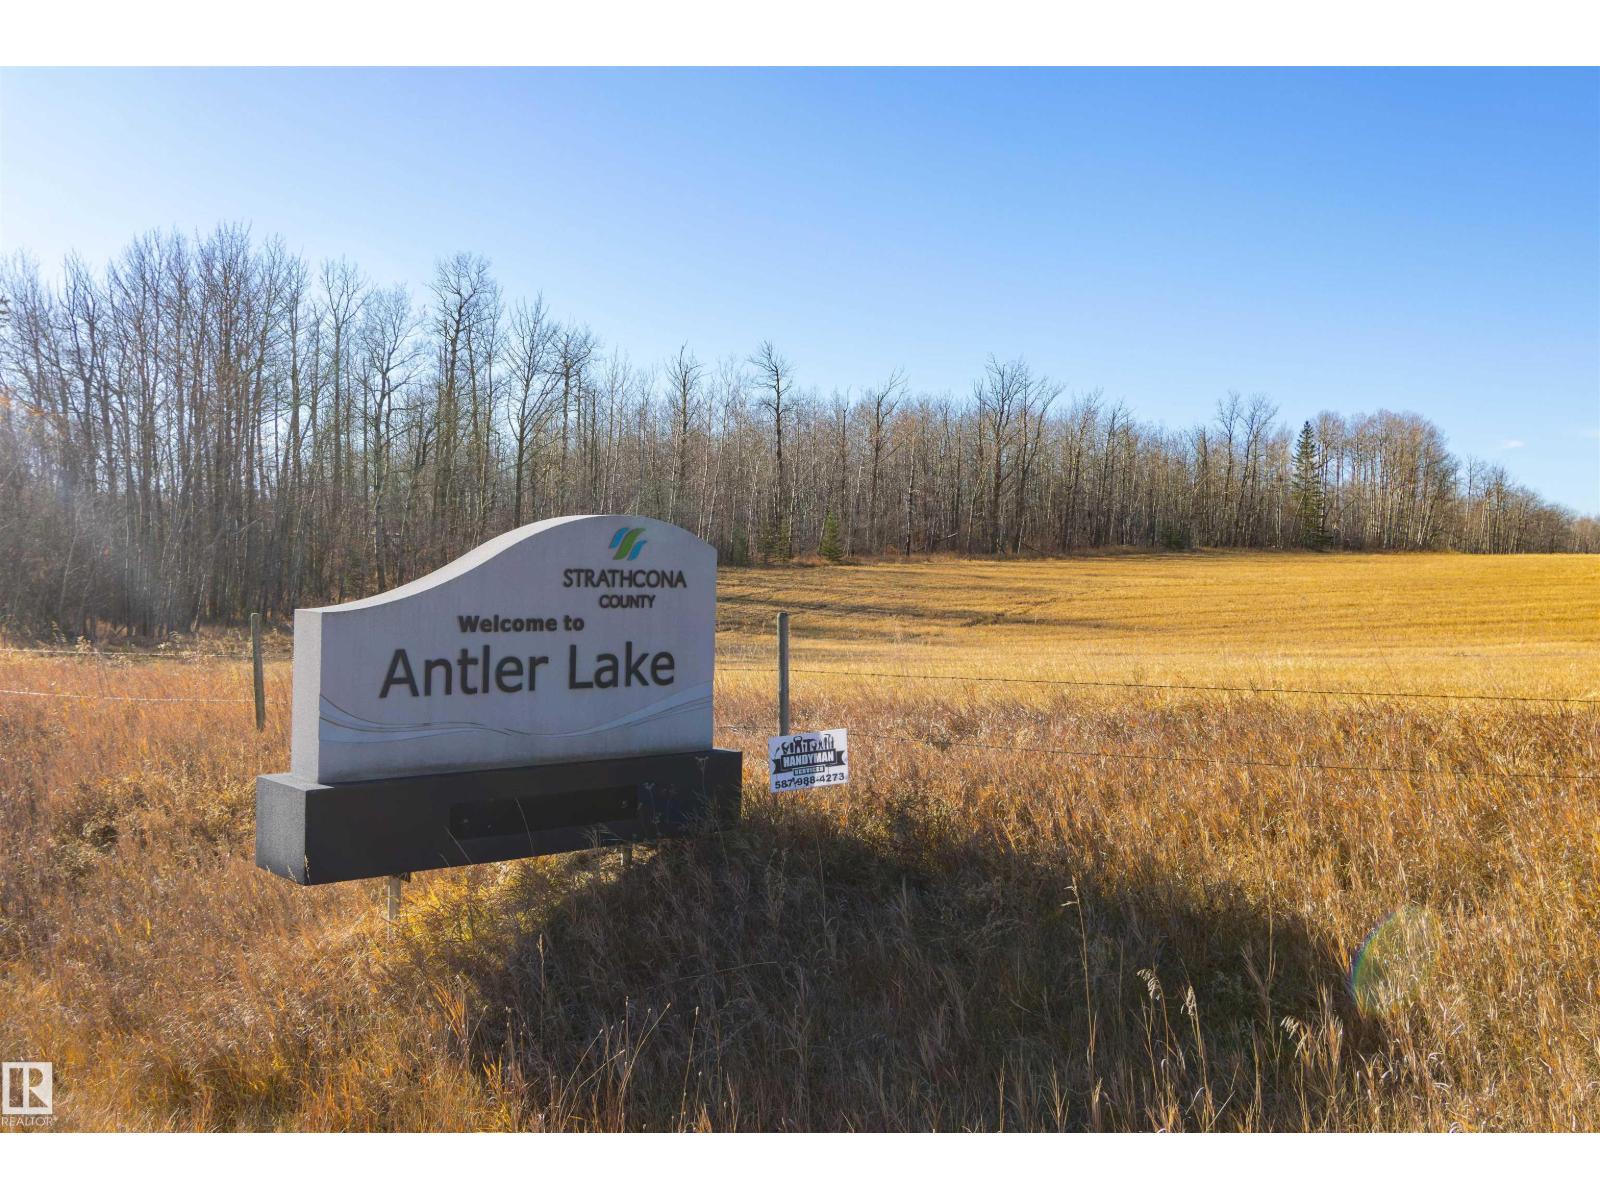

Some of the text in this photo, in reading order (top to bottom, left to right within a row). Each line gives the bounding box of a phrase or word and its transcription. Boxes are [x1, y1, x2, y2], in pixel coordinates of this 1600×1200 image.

[563, 569, 687, 589] STRATHCONA
[599, 594, 656, 609] COUNTY
[458, 615, 585, 633] Welcome to
[378, 641, 675, 699] Antler Lake
[783, 751, 834, 767] HANDYMAN
